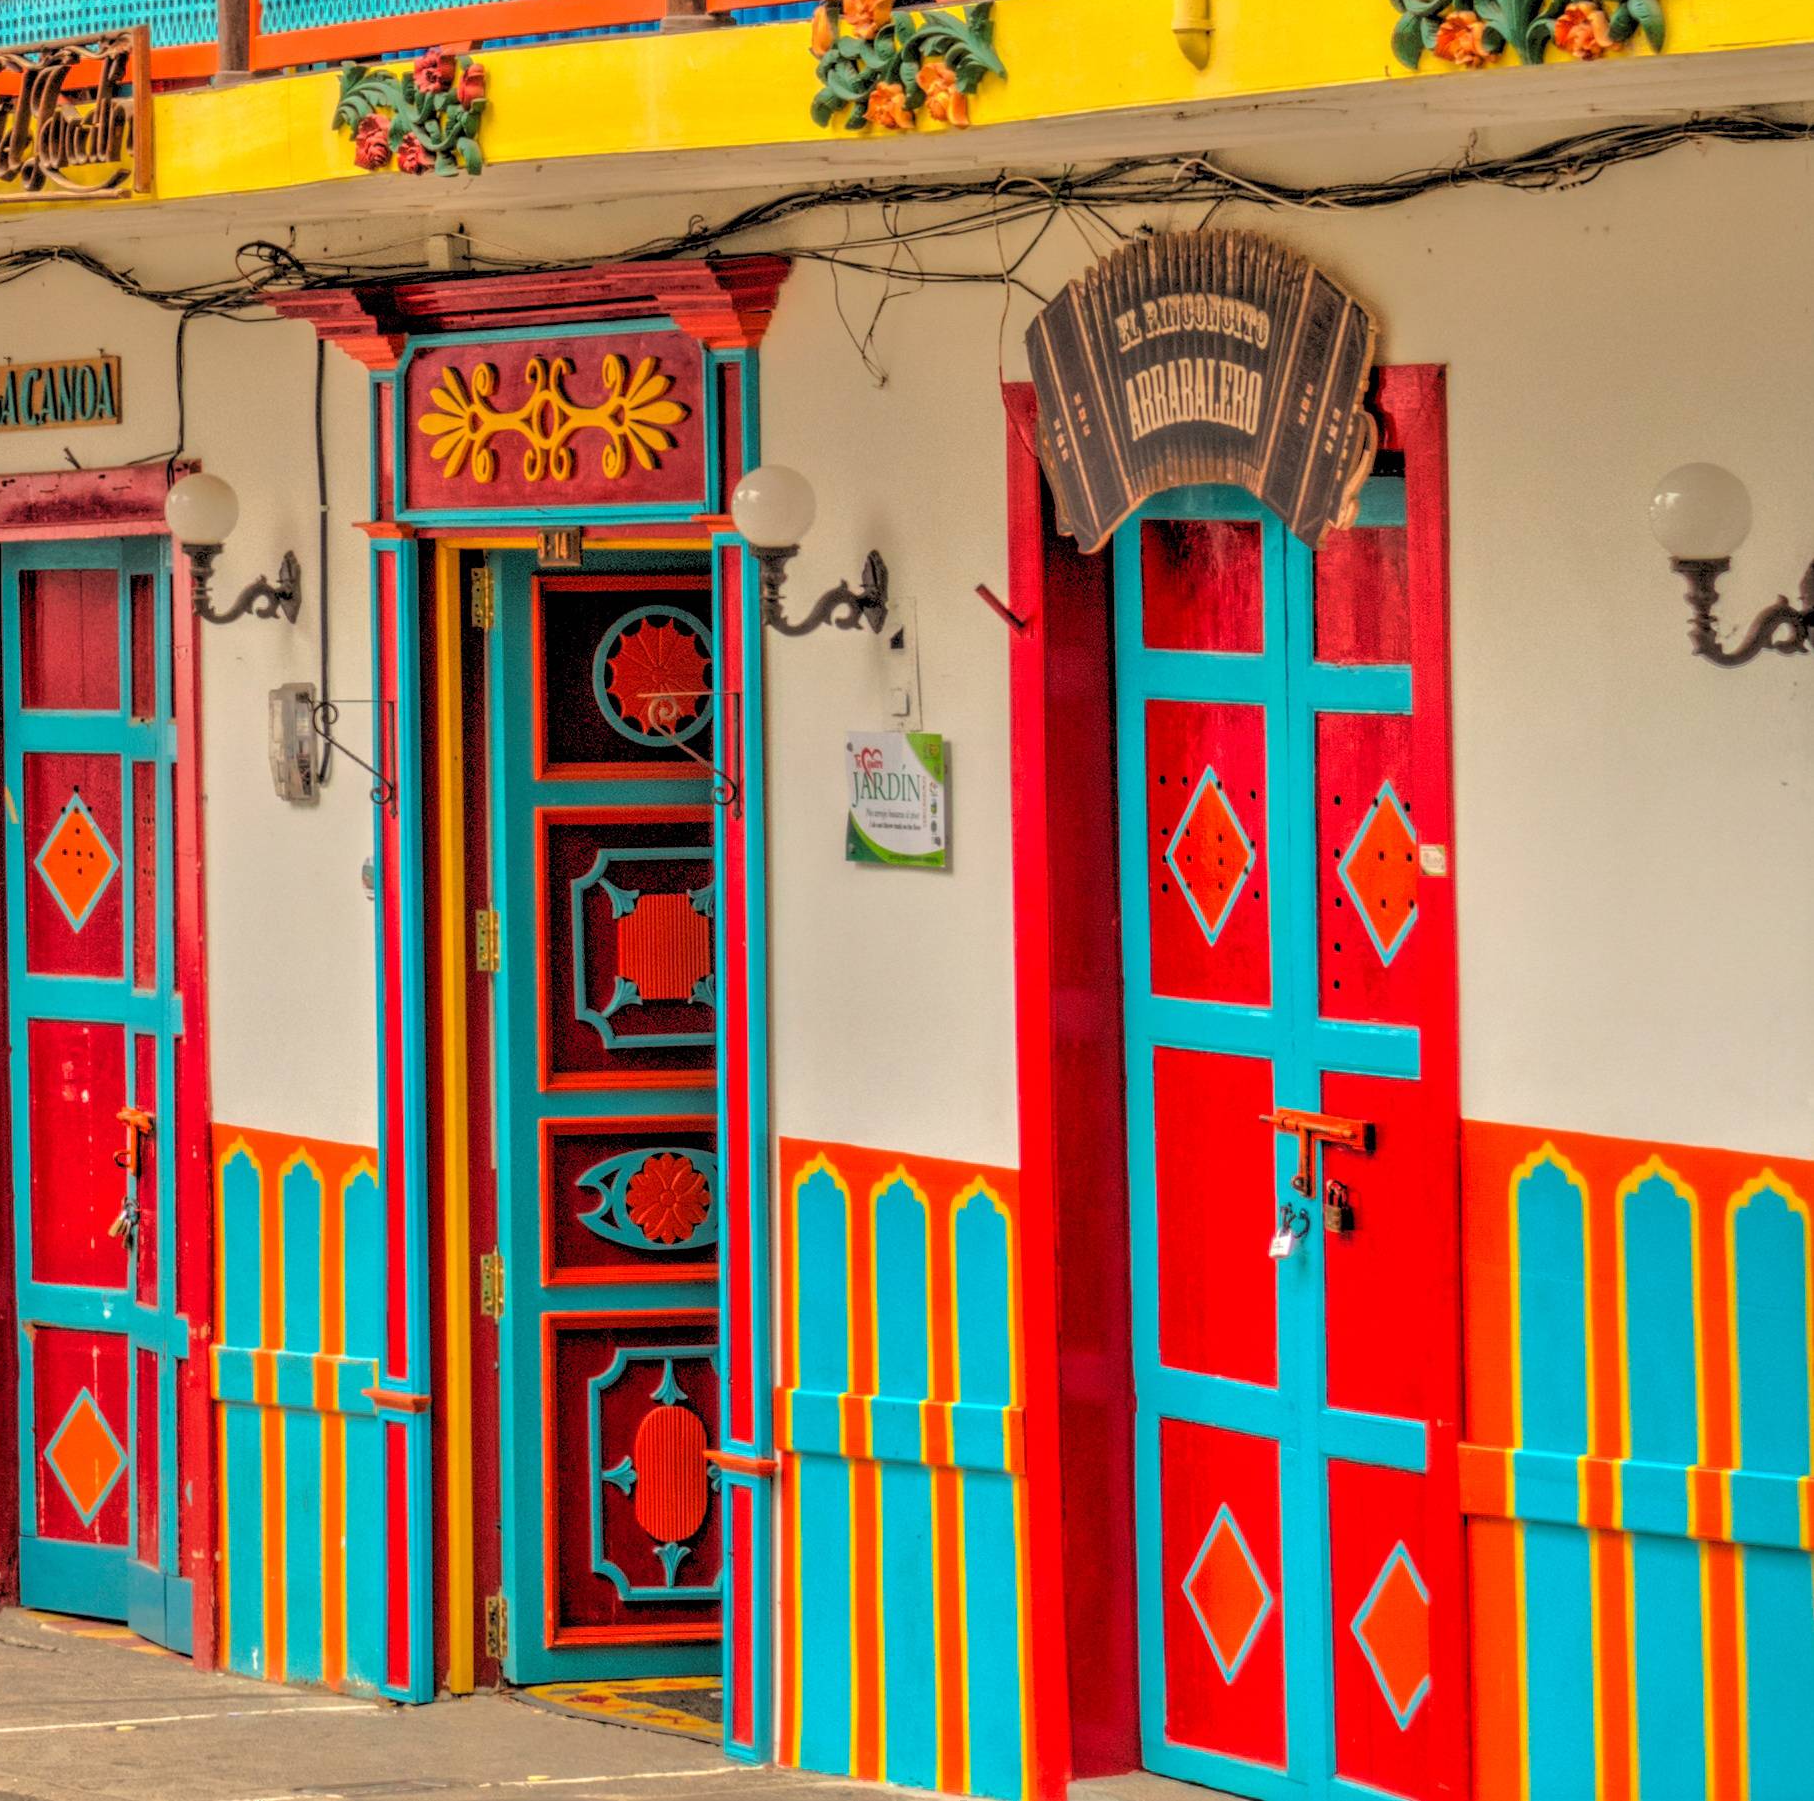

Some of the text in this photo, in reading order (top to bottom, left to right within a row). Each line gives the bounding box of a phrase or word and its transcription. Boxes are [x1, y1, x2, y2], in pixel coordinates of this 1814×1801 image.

[1115, 292, 1270, 353] EL RINCONCITO
[19, 362, 116, 426] CANOA
[1125, 357, 1263, 442] ARRABALERO
[852, 764, 921, 808] JARDÍN
